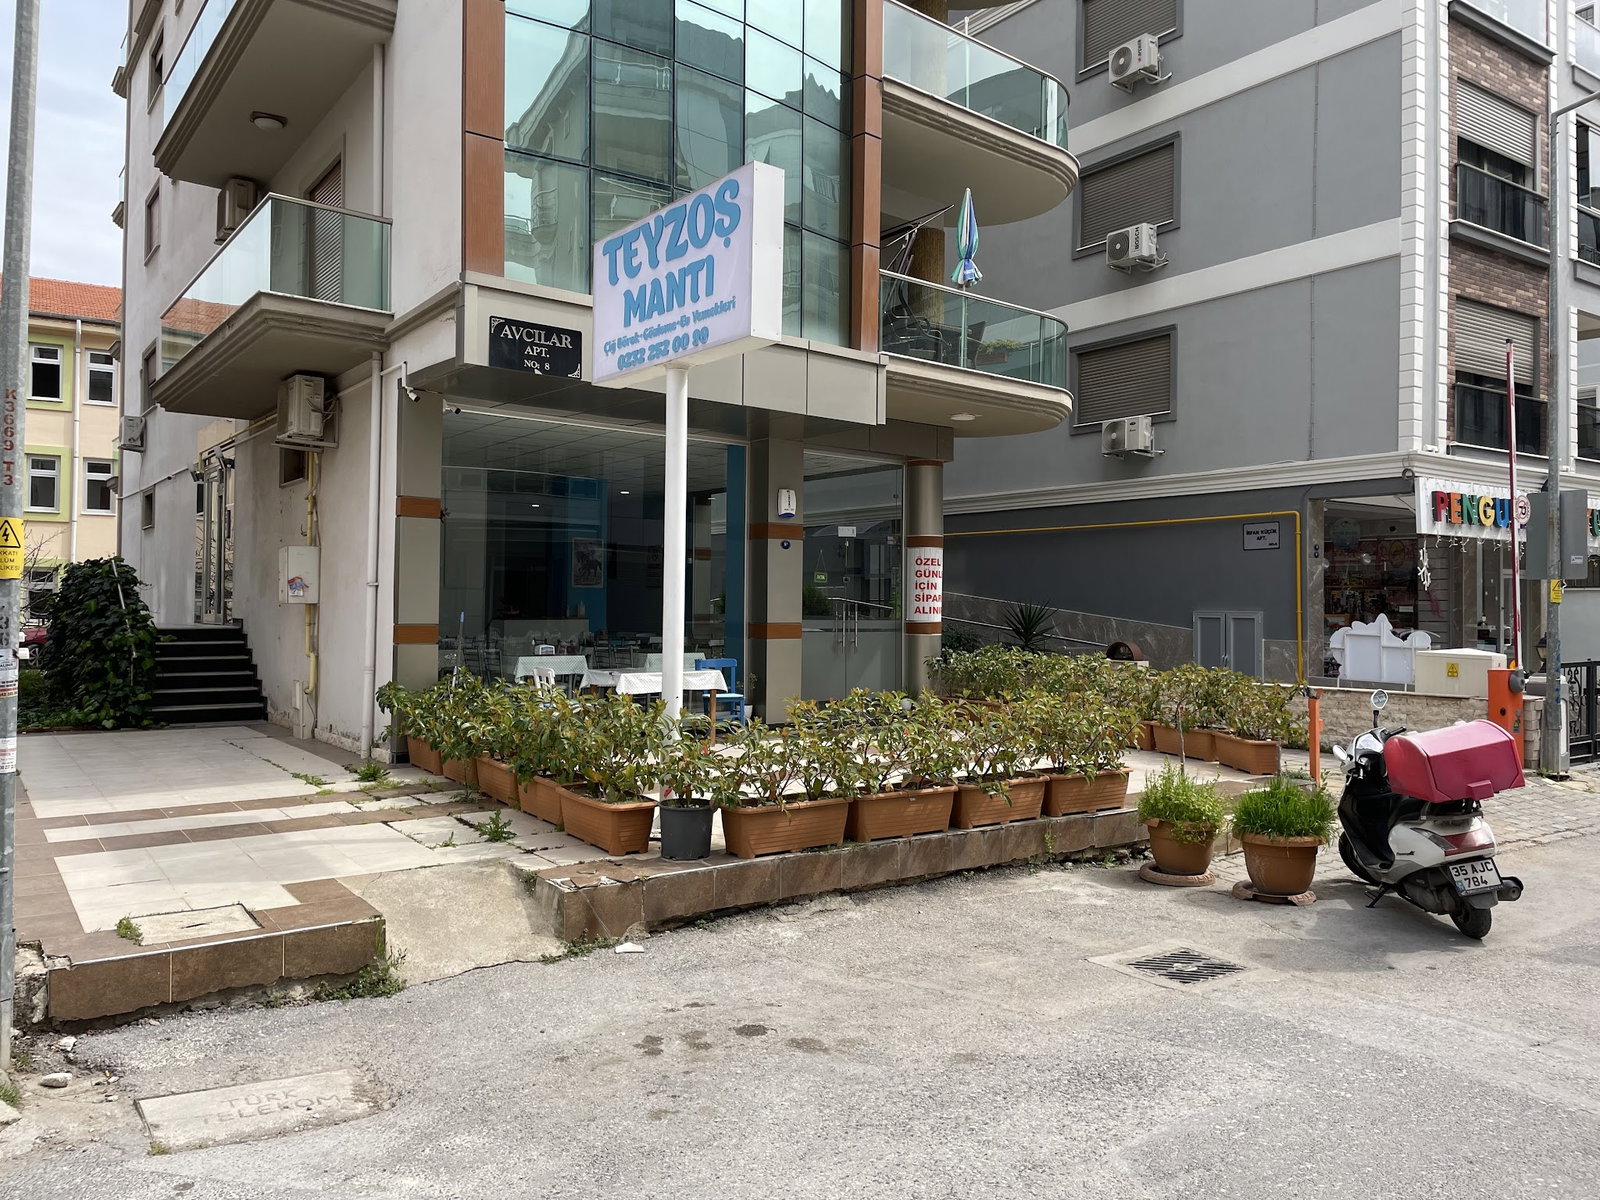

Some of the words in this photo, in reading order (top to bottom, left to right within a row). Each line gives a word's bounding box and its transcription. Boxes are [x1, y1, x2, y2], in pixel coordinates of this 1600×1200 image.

[602, 178, 742, 287] TEYZOŞ
[623, 254, 715, 328] MANTI
[500, 324, 573, 349] AVCILAR
[524, 345, 550, 358] APT.
[617, 347, 646, 371] 0232
[671, 333, 690, 353] 00
[523, 359, 540, 369] NO:
[544, 362, 550, 371] 8
[1432, 490, 1514, 529] PENGU
[915, 556, 941, 566] ÖZEL
[915, 568, 943, 579] GÜNL
[915, 580, 937, 592] İÇİN
[1452, 865, 1468, 877] 35
[1471, 861, 1493, 874] AJC
[1464, 876, 1488, 888] 784
[194, 1094, 342, 1125] TELEKOM
